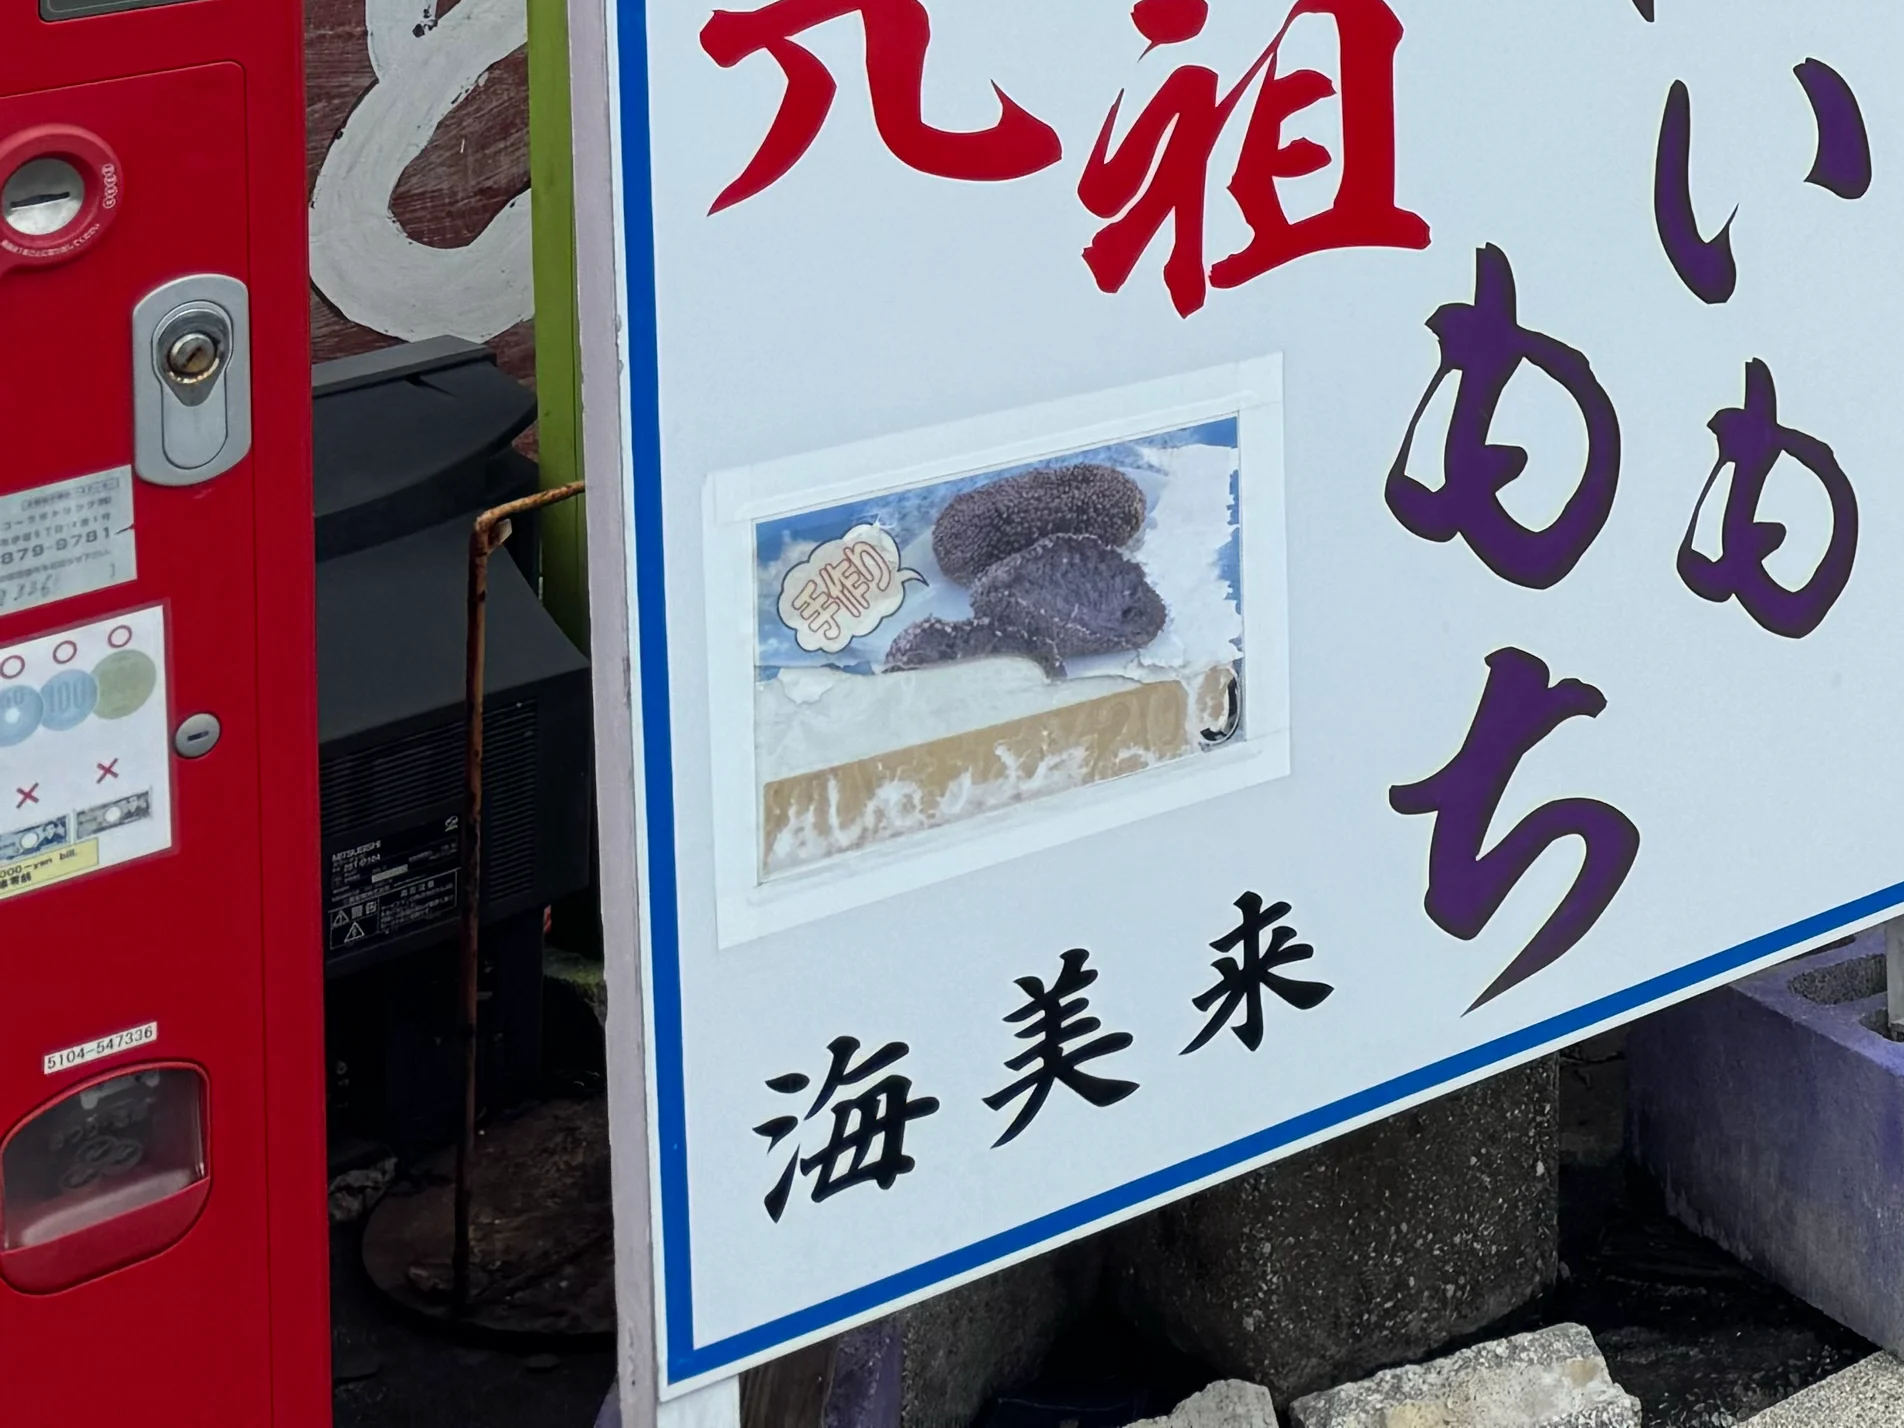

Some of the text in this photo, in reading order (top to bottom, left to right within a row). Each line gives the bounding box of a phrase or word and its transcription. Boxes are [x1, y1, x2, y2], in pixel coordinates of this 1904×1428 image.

[791, 539, 893, 641] 手作り
[1384, 241, 1641, 1018] もち
[46, 1024, 155, 1072] 5104-547336
[753, 890, 1335, 1225] 海美来
